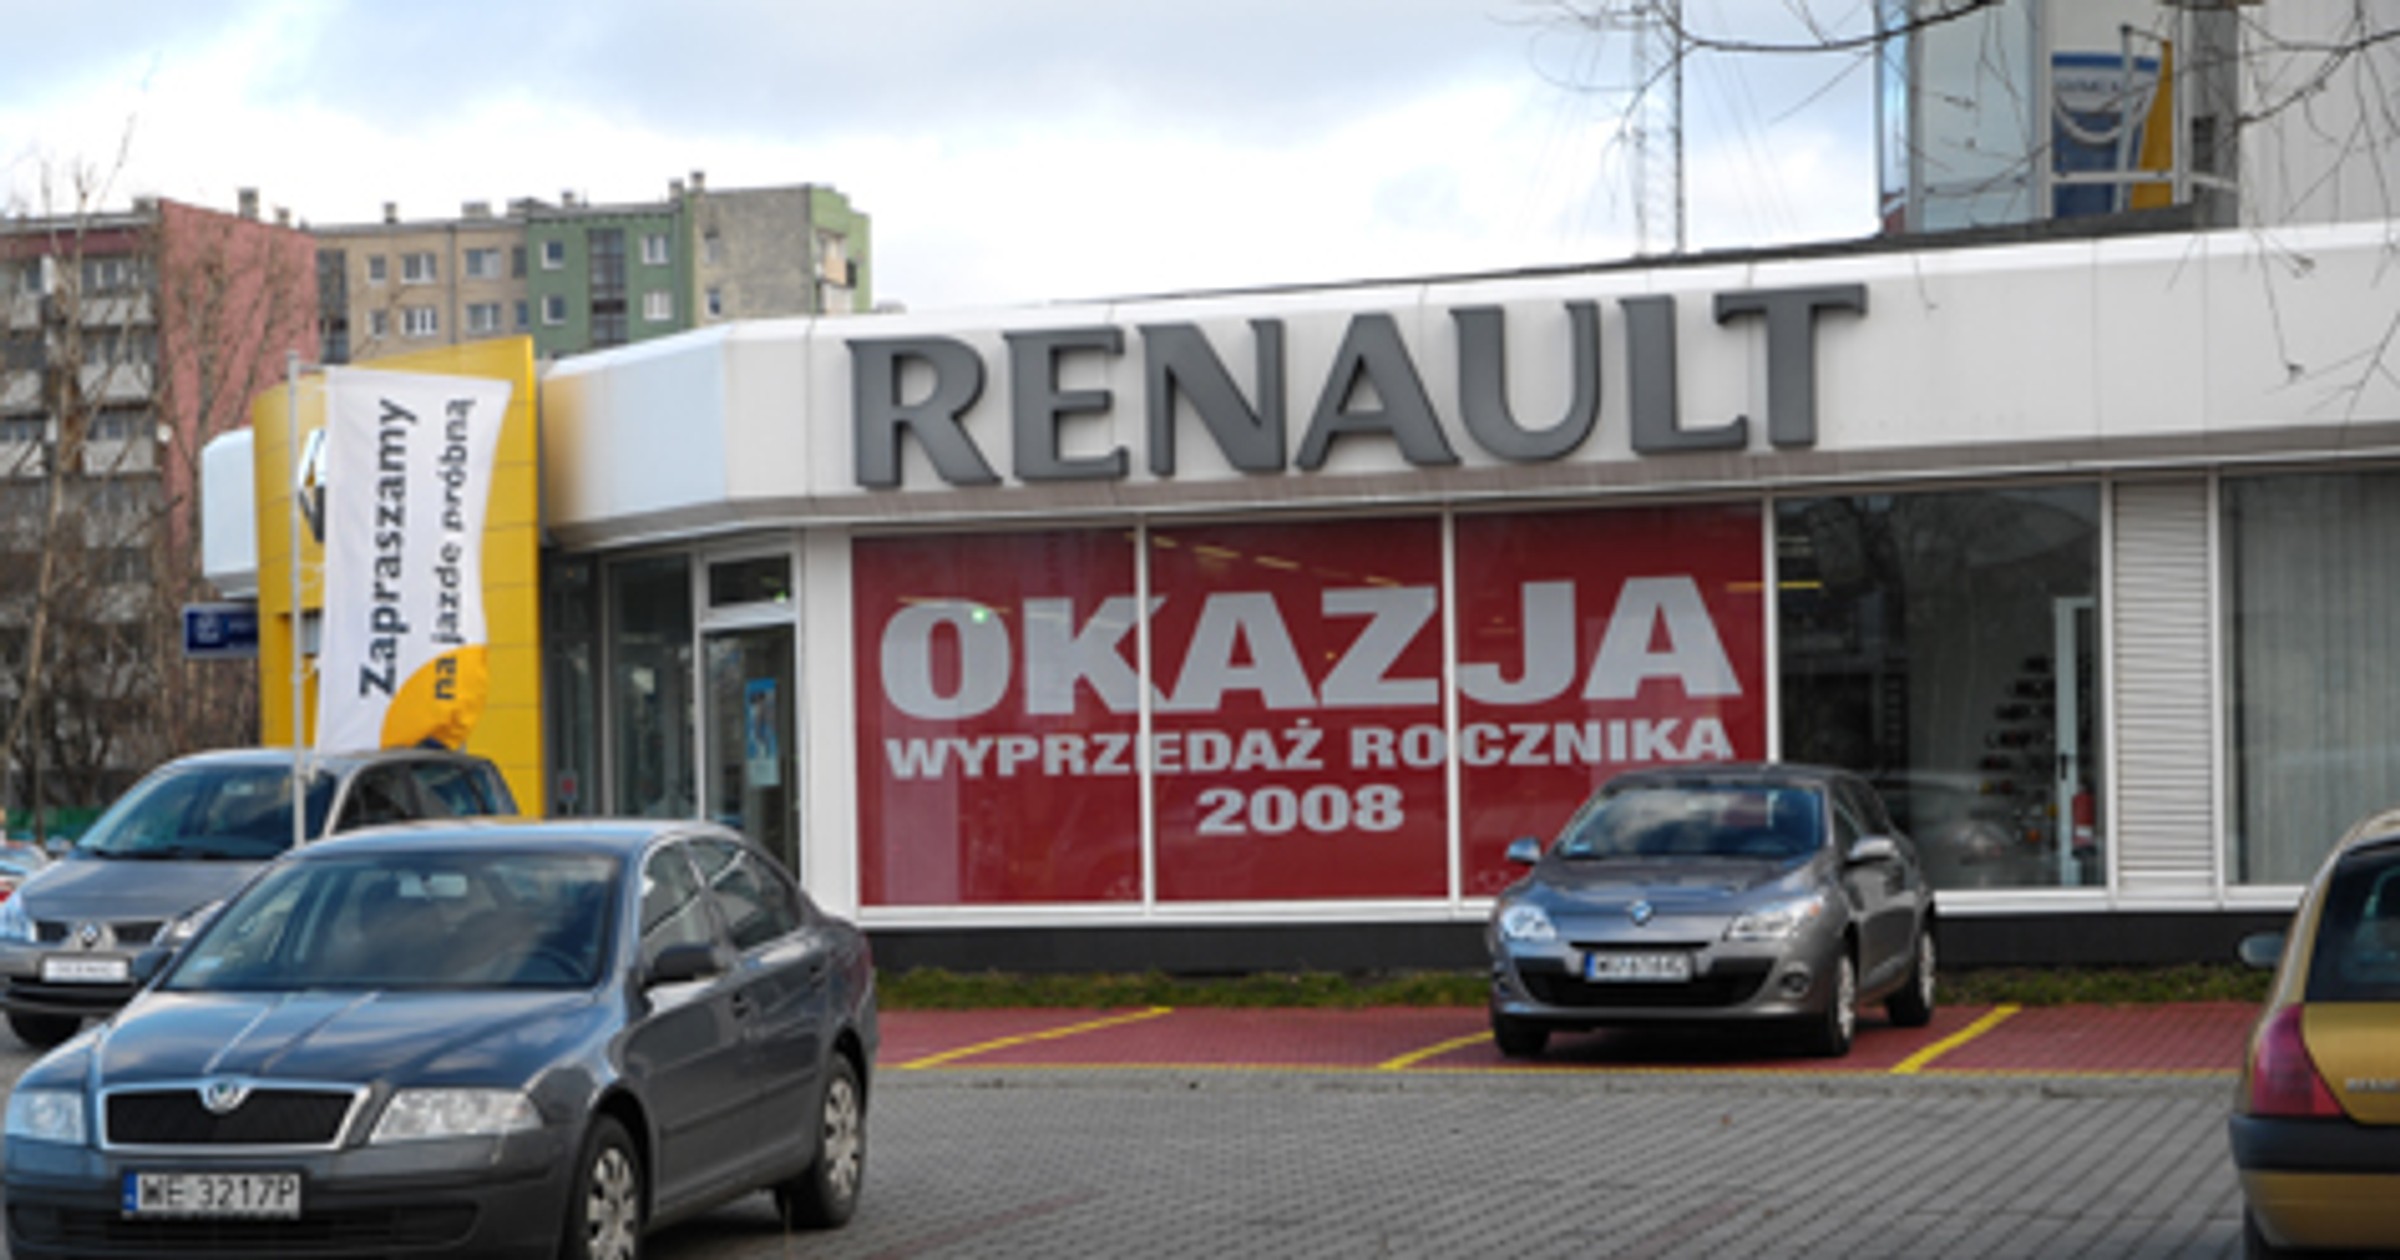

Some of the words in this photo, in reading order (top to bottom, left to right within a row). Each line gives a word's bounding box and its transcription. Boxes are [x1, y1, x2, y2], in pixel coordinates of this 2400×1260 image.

[846, 283, 1868, 489] RENAULT
[359, 398, 418, 698] Zapraszamy
[434, 656, 456, 700] na
[880, 575, 1743, 720] OKAZJA
[885, 718, 1324, 779] WYPRZEDAŻ
[1350, 717, 1736, 770] ROCZNIKA
[1196, 784, 1405, 836] 2008
[141, 1175, 184, 1208] WE
